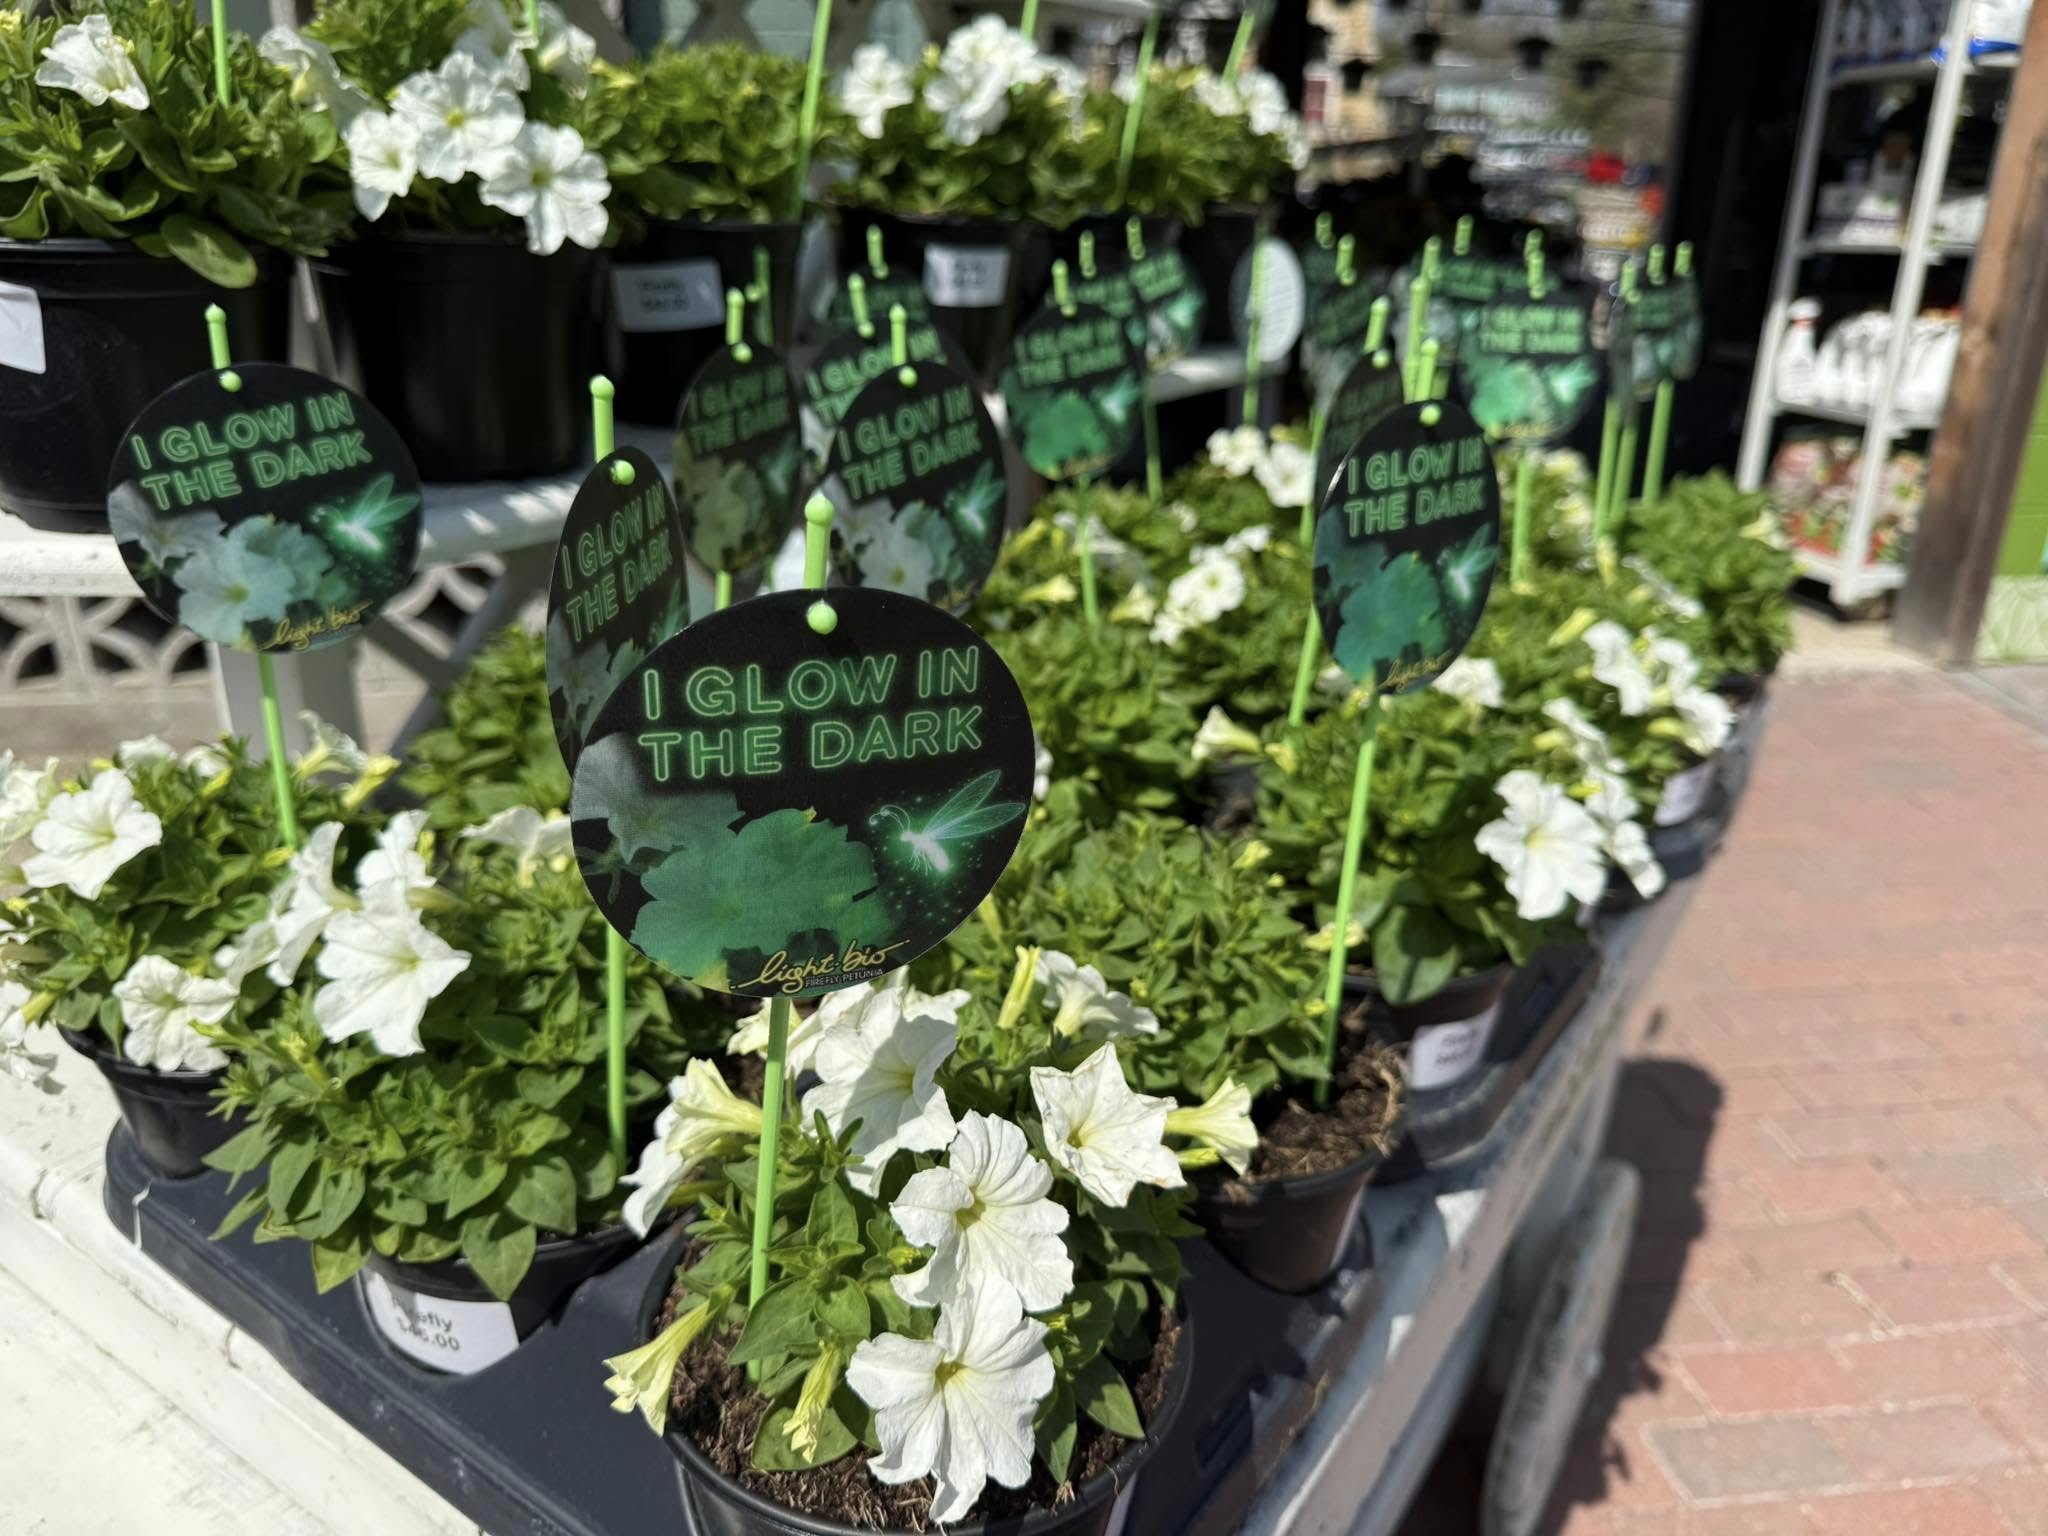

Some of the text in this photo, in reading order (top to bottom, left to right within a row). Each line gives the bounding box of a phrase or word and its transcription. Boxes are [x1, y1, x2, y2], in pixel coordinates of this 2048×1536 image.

[131, 390, 355, 470] I GLOW IN
[839, 428, 850, 463] I
[854, 396, 939, 453] GLOW
[943, 386, 974, 426] IN
[842, 421, 982, 500] THE DARK
[140, 429, 373, 511] THE DARK
[1347, 437, 1483, 494] I GLOW IN
[561, 481, 666, 590] I GLOW IN
[1344, 476, 1485, 538] THE DARK
[566, 528, 672, 643] THE DARK
[643, 645, 979, 720] I GLOW IN
[639, 706, 982, 782] THE DARK
[805, 968, 884, 988] FIREFLY PETUNIA
